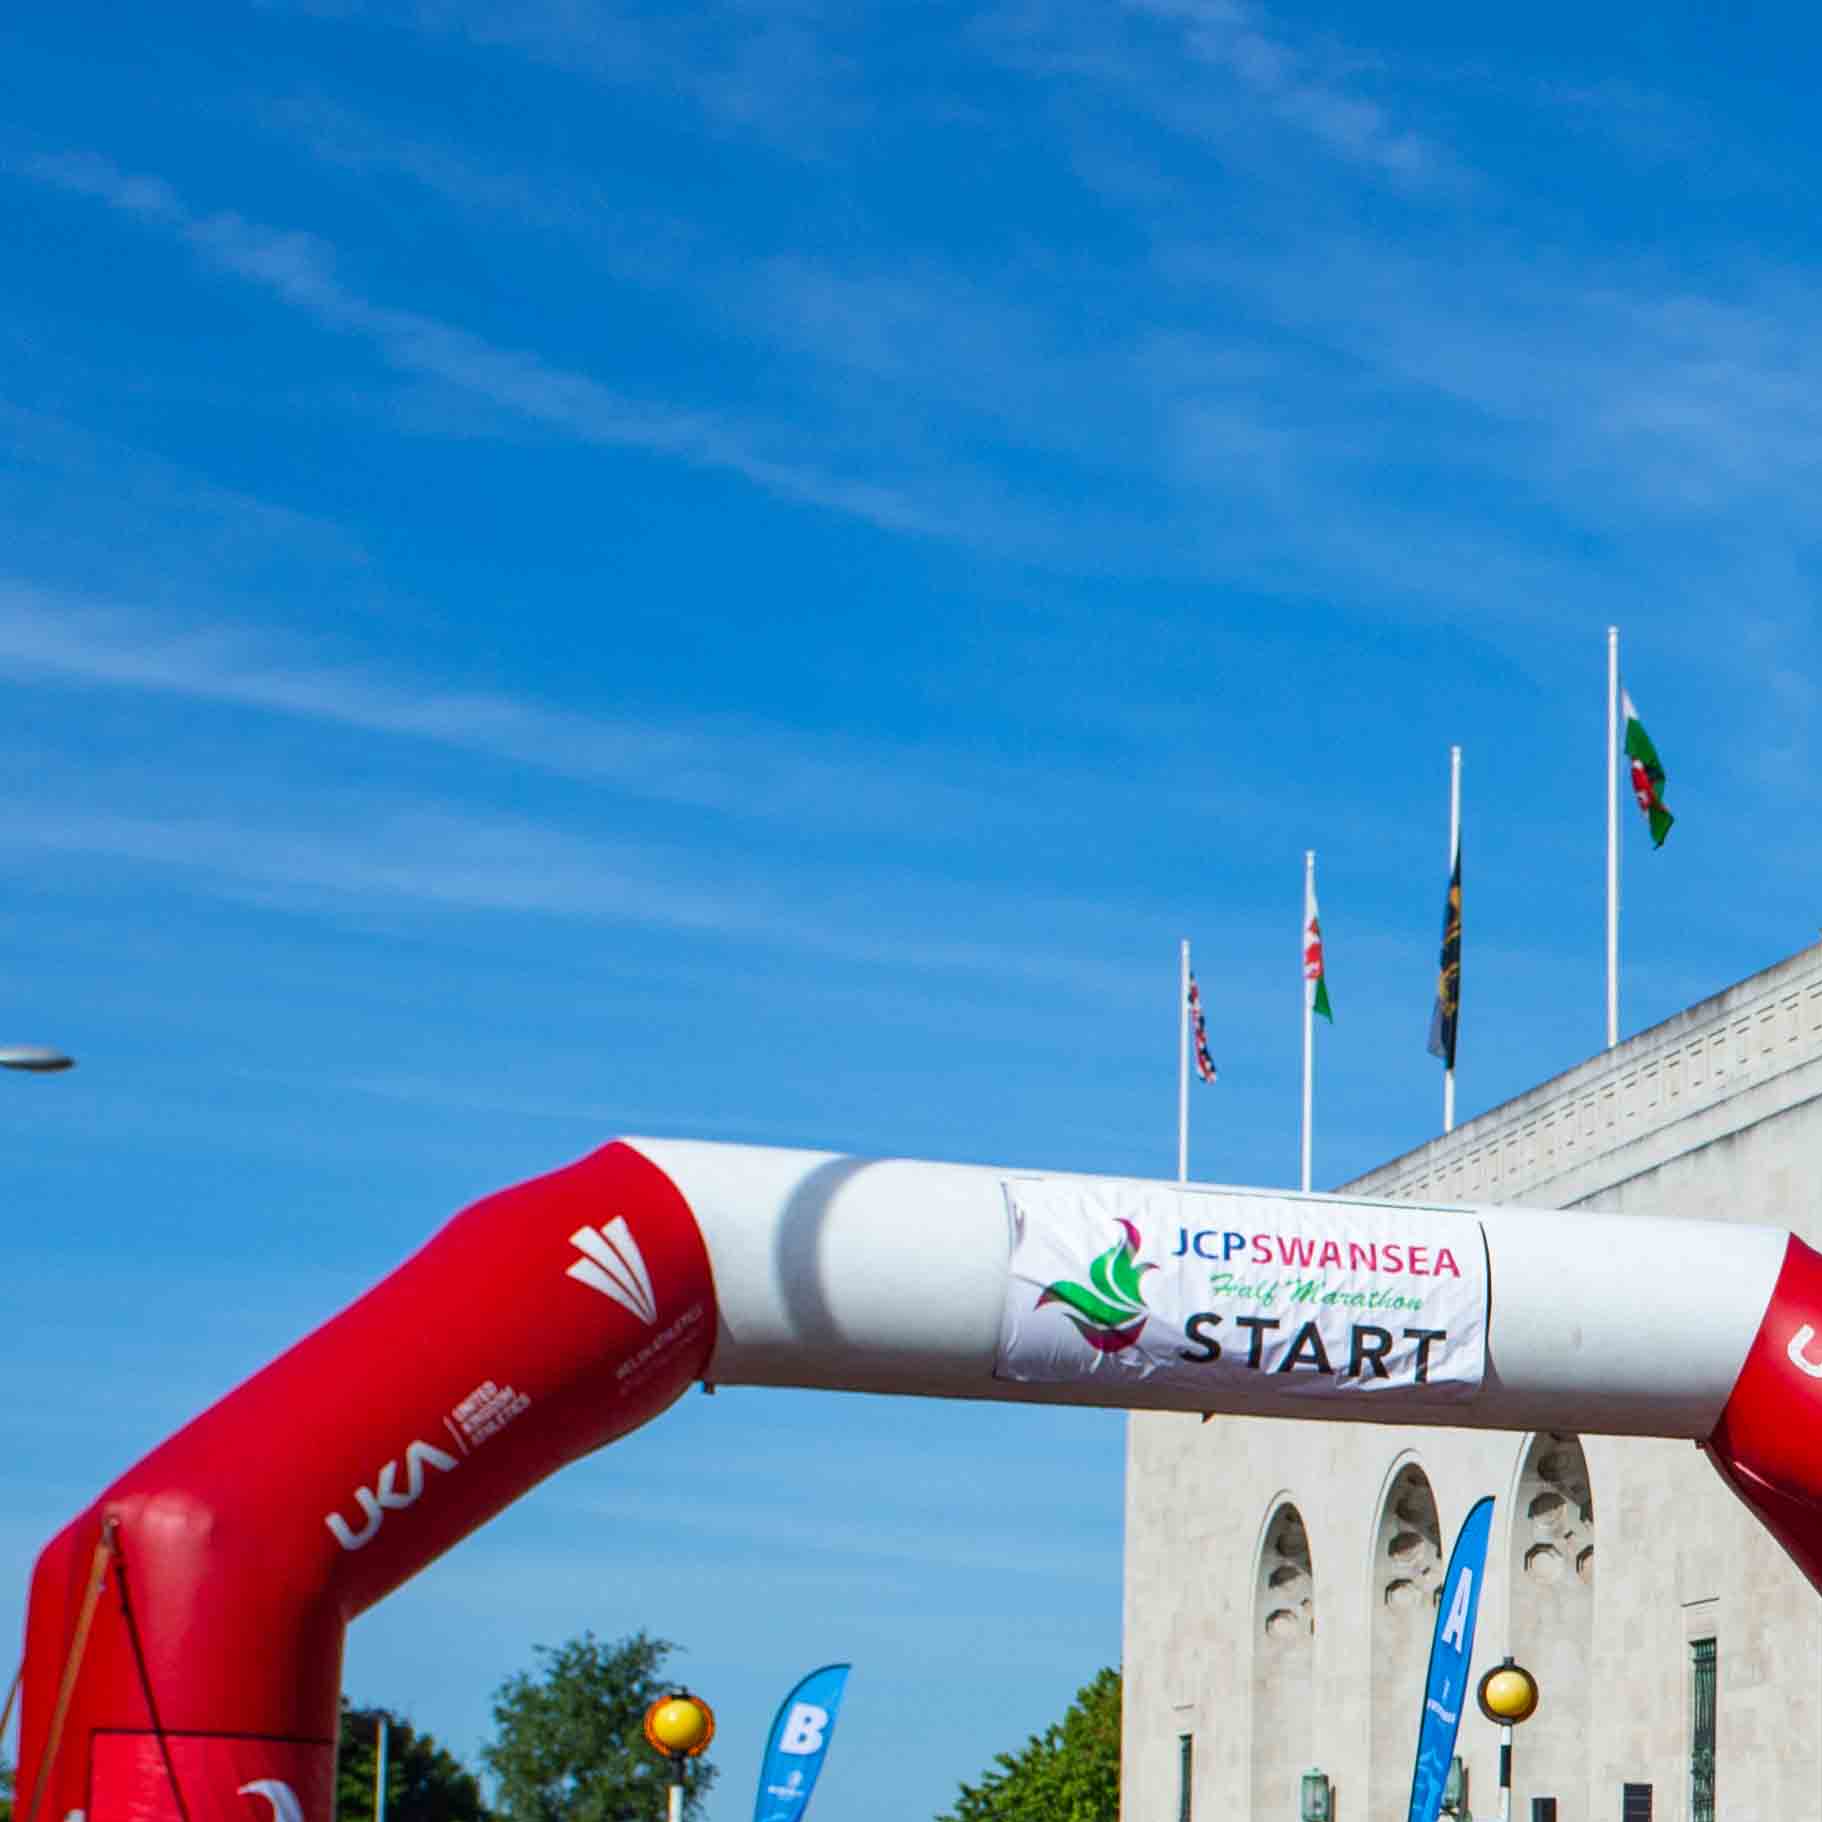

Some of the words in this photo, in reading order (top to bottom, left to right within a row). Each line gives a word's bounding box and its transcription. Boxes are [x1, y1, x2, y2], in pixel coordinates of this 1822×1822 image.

[1171, 1226, 1462, 1279] JCPSWANSEA
[1208, 1271, 1282, 1307] Half
[1283, 1276, 1425, 1312] Marathon
[1178, 1310, 1448, 1384] START
[324, 1439, 460, 1551] UKA
[1441, 1566, 1473, 1654] A
[778, 1702, 829, 1755] B
